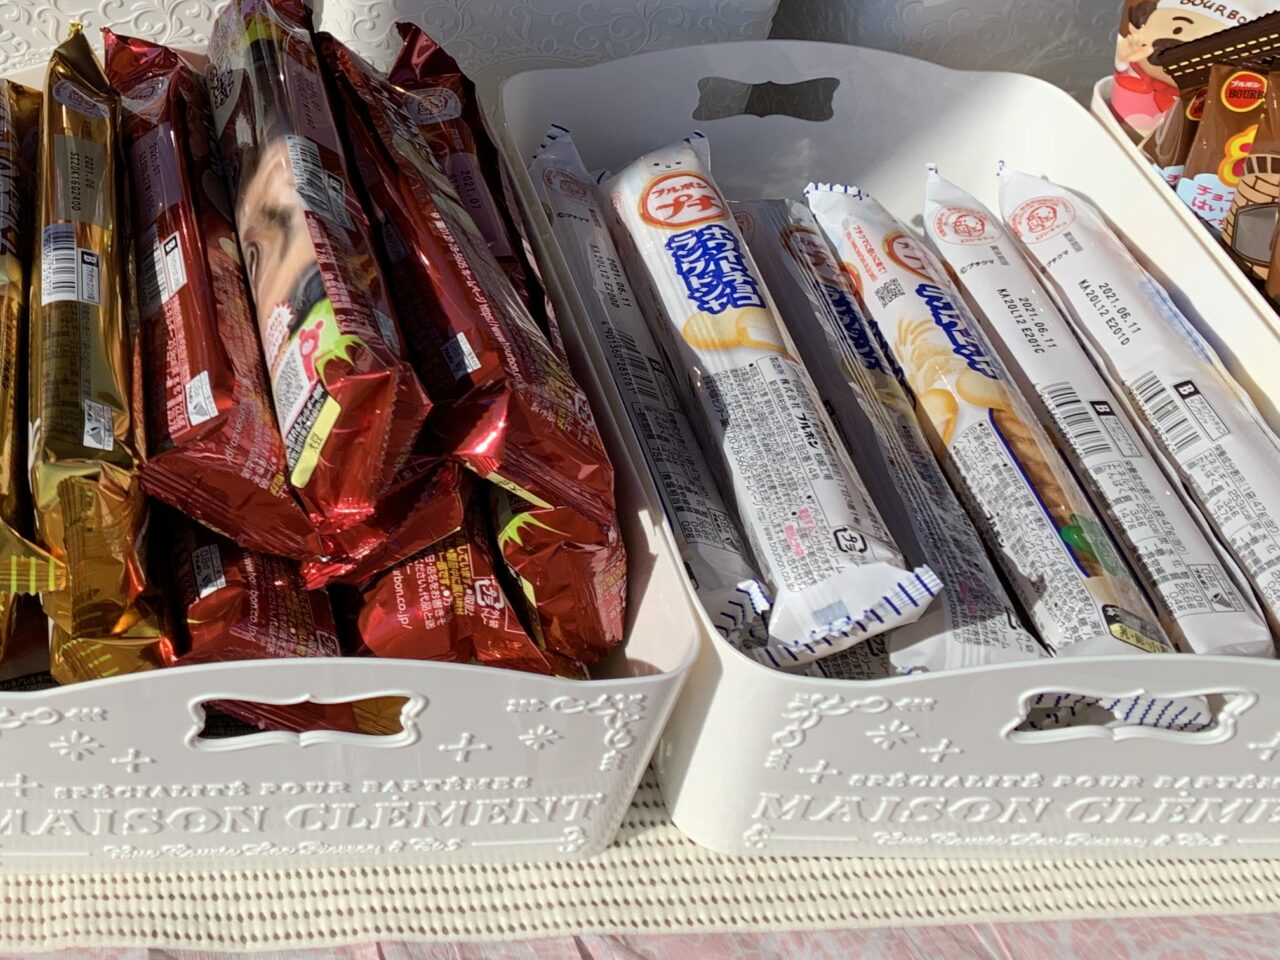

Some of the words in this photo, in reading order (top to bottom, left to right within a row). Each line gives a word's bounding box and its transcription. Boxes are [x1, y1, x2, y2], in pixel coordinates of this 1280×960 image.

[1228, 88, 1267, 101] BOURB
[464, 169, 482, 210] 2021.07
[651, 179, 710, 198] ブルボン
[655, 193, 721, 221] プチ
[671, 233, 727, 312] ラングドシャ
[702, 227, 763, 309] ホワイトチョコ
[996, 288, 1026, 326] KA20L12
[1077, 277, 1110, 319] KA20L12
[1098, 281, 1142, 335] 2021.06.11
[1017, 296, 1058, 350] 2021.06.11
[1177, 382, 1197, 396] B
[1093, 403, 1112, 414] B
[794, 412, 820, 450] ブルボン
[260, 781, 348, 796] POUR
[1053, 774, 1145, 790] POUR
[751, 792, 1052, 823] MAISON
